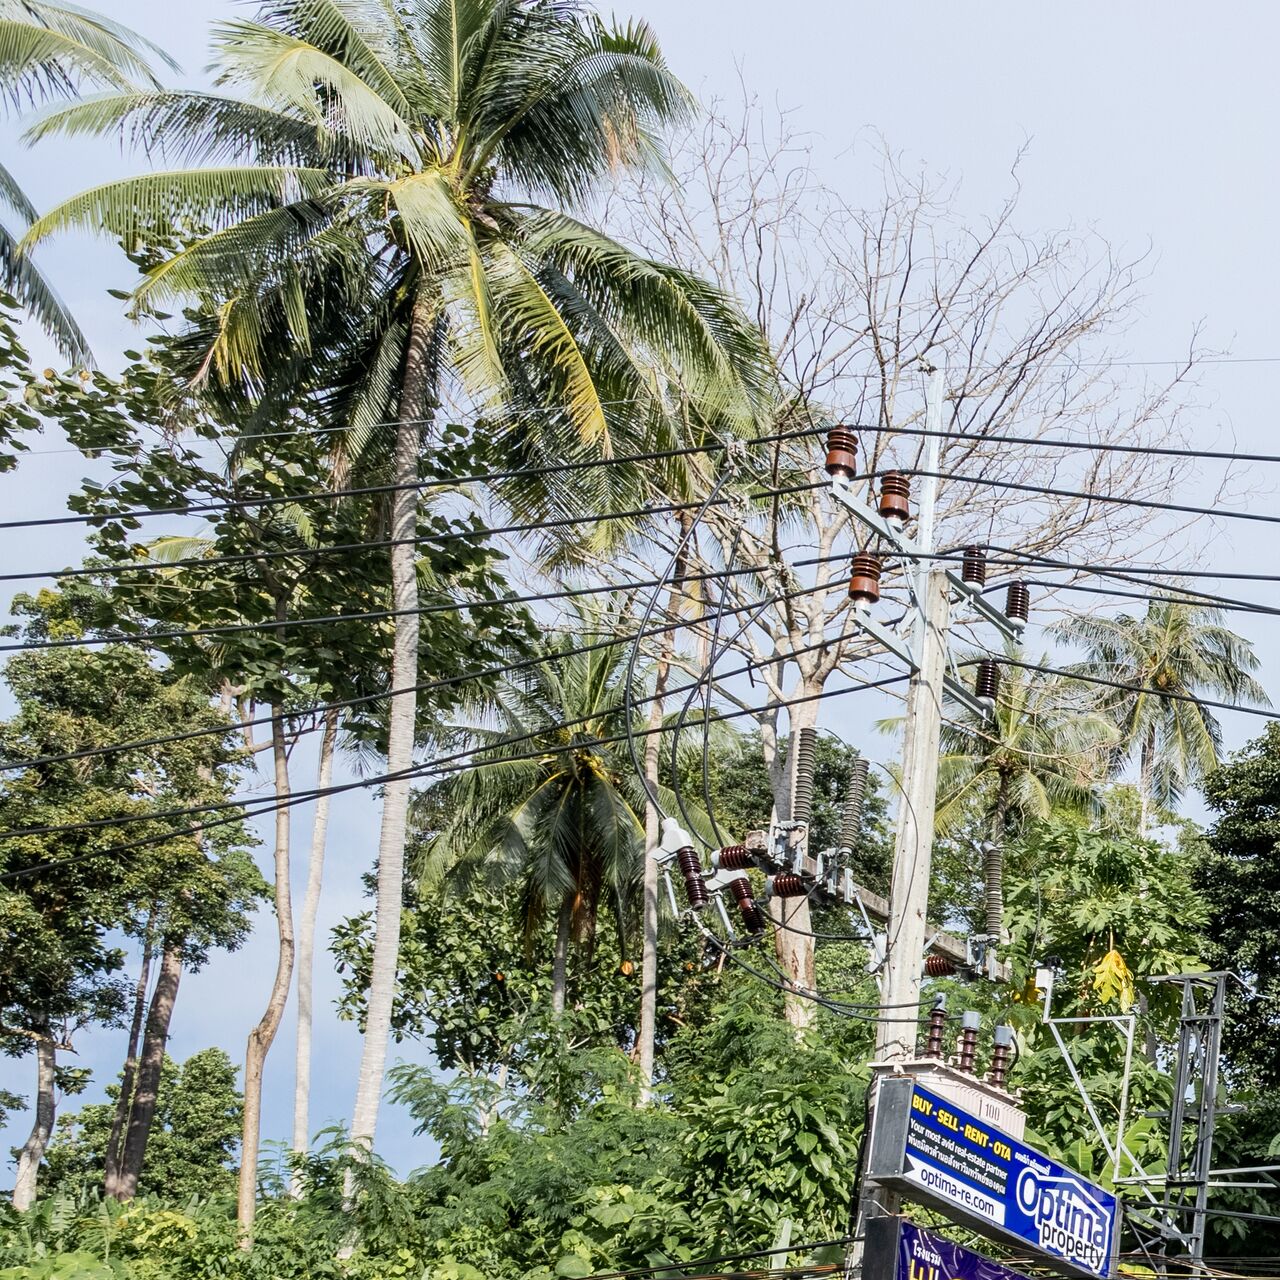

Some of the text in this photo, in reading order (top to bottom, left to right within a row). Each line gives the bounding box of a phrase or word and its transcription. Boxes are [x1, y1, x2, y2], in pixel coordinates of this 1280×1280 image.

[912, 1094, 1012, 1161] BUY SELL RENT OTA
[985, 1104, 1000, 1121] 100
[910, 1118, 925, 1135] Your
[925, 1128, 941, 1144] most
[941, 1137, 954, 1152] avid
[954, 1145, 986, 1168] real-estate
[985, 1162, 1008, 1180] partner
[920, 1168, 995, 1217] optima-re.com
[1019, 1171, 1107, 1250] Optima
[912, 1239, 942, 1266] โรงแรม
[1042, 1222, 1104, 1269] property
